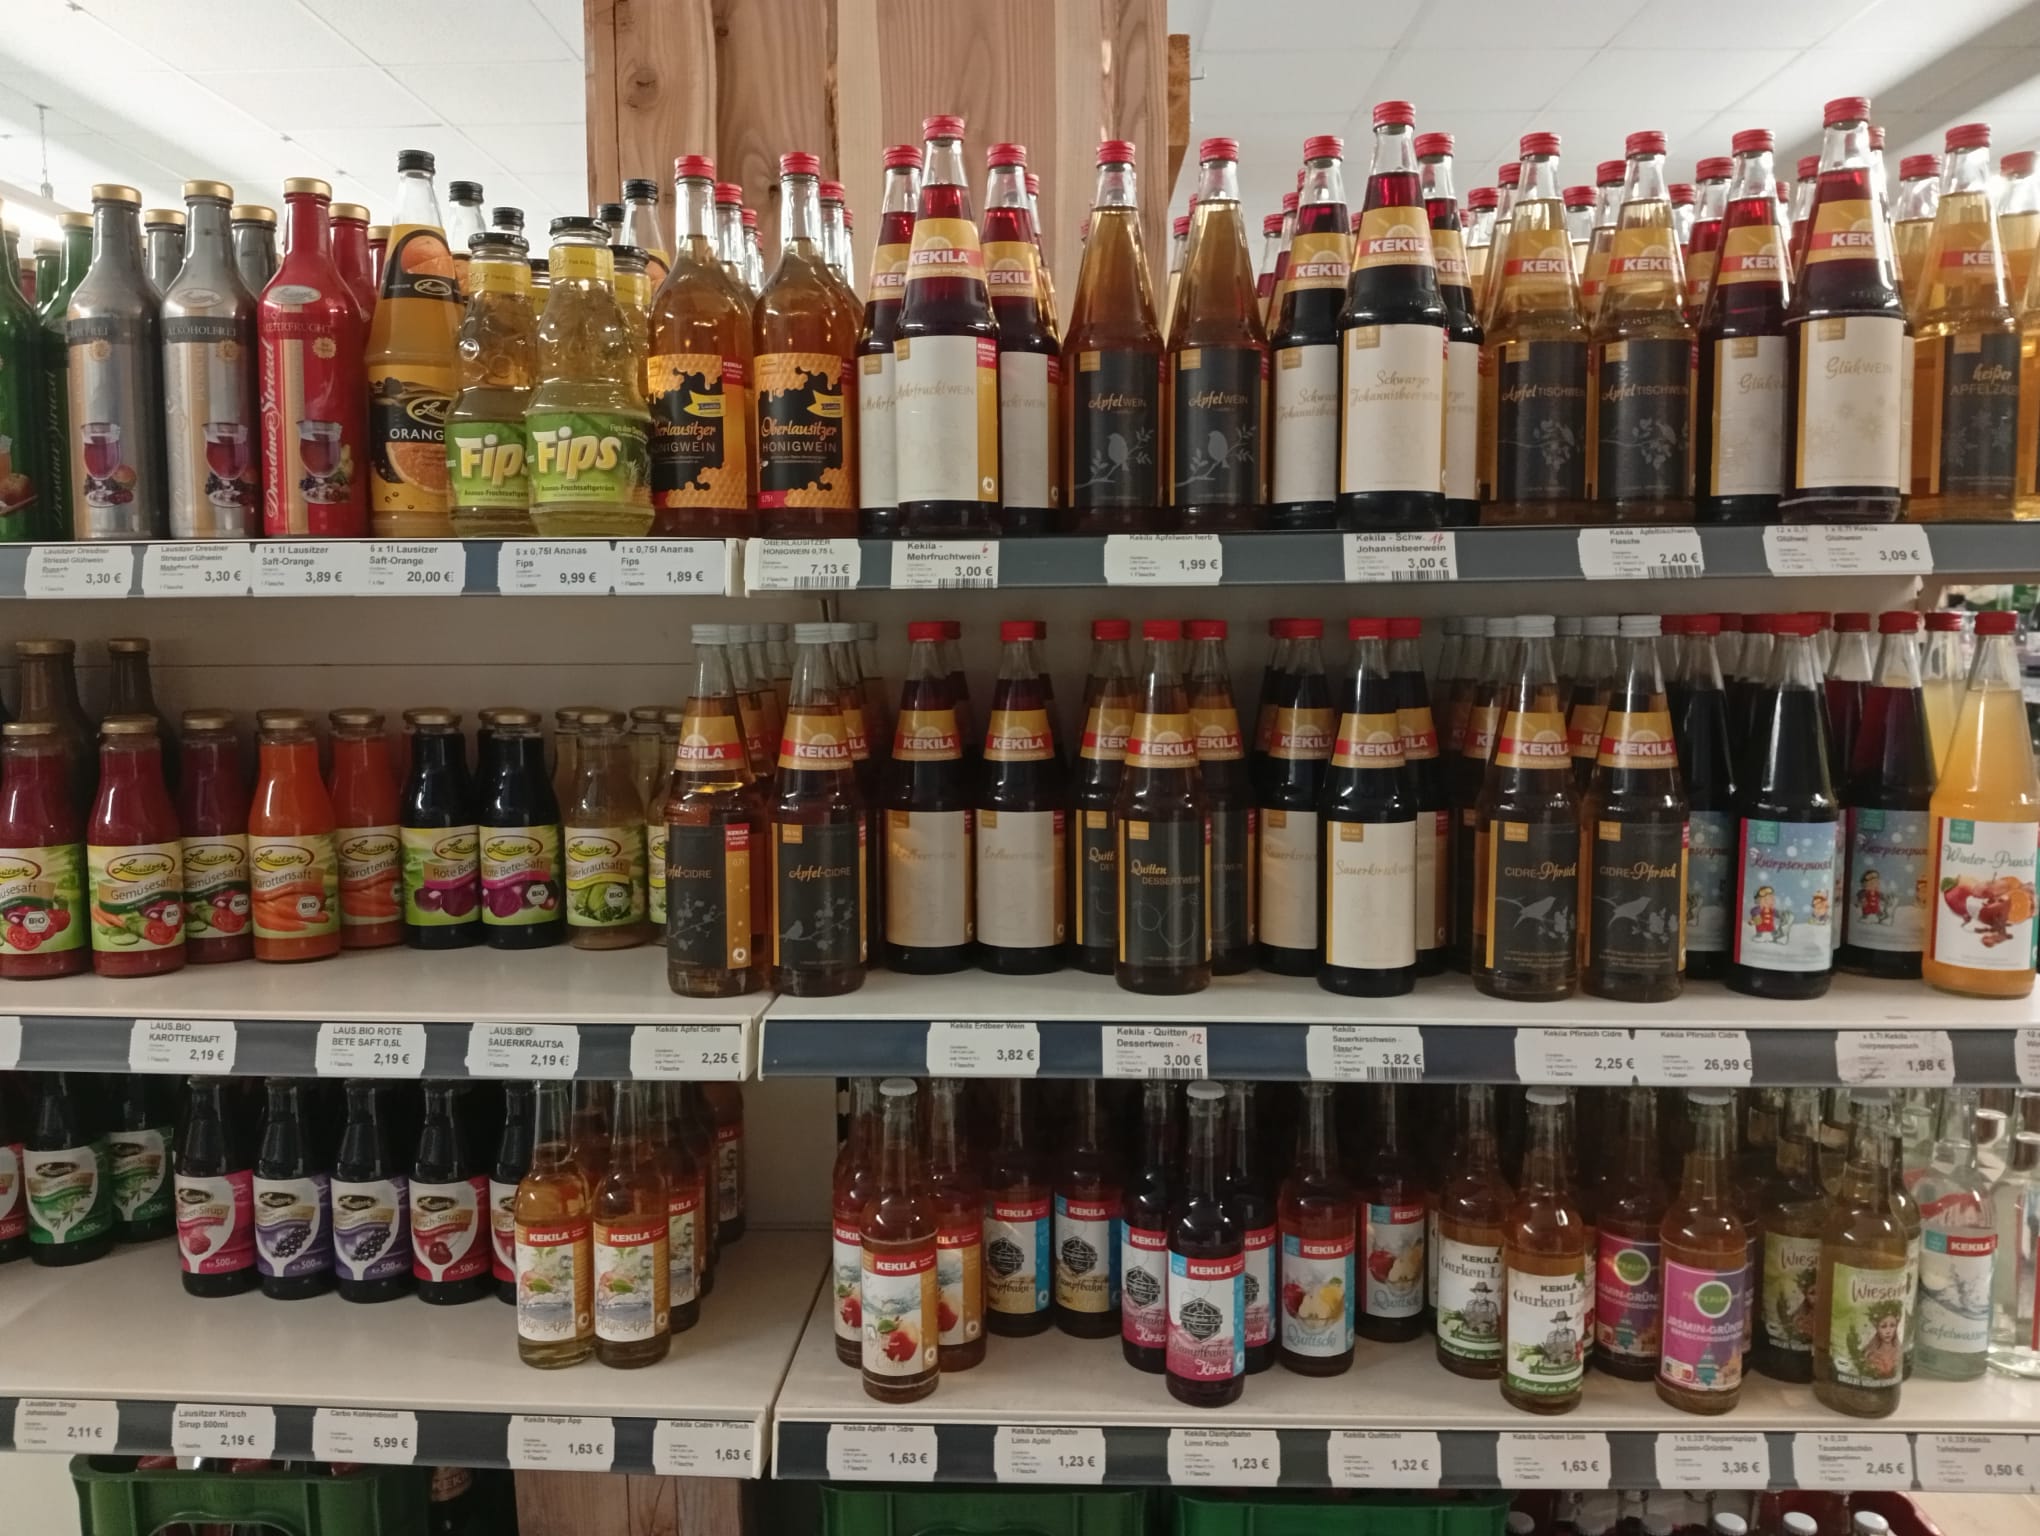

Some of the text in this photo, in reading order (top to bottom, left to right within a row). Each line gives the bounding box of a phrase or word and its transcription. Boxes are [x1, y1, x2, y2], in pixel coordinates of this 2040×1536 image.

[911, 250, 969, 266] KEKILA
[761, 416, 836, 440] Oberlausitzer
[533, 426, 622, 480] Fips
[288, 546, 328, 554] Lausitzer
[554, 547, 587, 555] Ananas
[907, 542, 936, 550] Kekila
[1357, 545, 1446, 553] Johannisbeerwein
[369, 556, 423, 566] Saft-Orange
[1659, 553, 1687, 564] 2,40
[1691, 553, 1699, 563] €
[1880, 550, 1920, 561] 3,09 €
[262, 558, 315, 566] Saft-Orange
[516, 559, 534, 568] Fips
[621, 557, 640, 566] Fips
[1179, 559, 1218, 571] 1,99 €
[1408, 558, 1448, 569] 3,00 €
[811, 564, 849, 576] 7,13 €
[955, 566, 993, 577] 3,00 €
[86, 573, 122, 585] 3,30 €
[205, 570, 241, 582] 3,30 €
[306, 572, 342, 584] 3,89 €
[407, 571, 440, 584] 20,00
[560, 572, 597, 585] 9,99 €
[666, 571, 703, 584] 1,89 €
[903, 737, 954, 749] KEKILA
[992, 736, 1044, 749] KEKILA
[1614, 742, 1672, 754] KEKILA
[794, 746, 847, 758] KEKILA
[1141, 743, 1194, 756] KEKILA
[1131, 859, 1167, 876] Quitten
[28, 916, 45, 924] BIO
[378, 1027, 402, 1035] ROTE
[1154, 1028, 1188, 1036] Quitten
[149, 1034, 220, 1043] KAROTTENSAFT
[332, 1038, 355, 1046] BETE
[488, 1039, 564, 1048] SAUERKRAUTSA
[1117, 1039, 1173, 1047] Dessertwein
[189, 1050, 214, 1061] 2,19
[374, 1053, 399, 1065] 2,19
[531, 1054, 556, 1066] 2,19
[702, 1053, 727, 1064] 2,25
[997, 1049, 1023, 1061] 3,82
[1164, 1055, 1190, 1066] 3,00
[1383, 1054, 1410, 1066] 3,82
[1595, 1058, 1623, 1071] 2,25
[1704, 1059, 1739, 1071] 26,99
[1907, 1060, 1934, 1072] 1,98
[997, 1208, 1032, 1217] KEKILA
[1070, 1207, 1106, 1216] KEKILA
[529, 1231, 569, 1242] KEKILA
[611, 1231, 650, 1242] KEKILA
[1304, 1245, 1342, 1254] KEKILA
[876, 1261, 916, 1271] KEKILA
[1190, 1265, 1231, 1275] KEKILA
[1195, 1360, 1232, 1375] Kirsch
[68, 1427, 91, 1438] 2,11
[1209, 1431, 1251, 1439] Dampfbahn
[221, 1435, 244, 1446] 2,19
[373, 1437, 398, 1449] 5,99
[1032, 1438, 1051, 1446] Apfel
[568, 1444, 593, 1455] 1,63
[715, 1449, 740, 1462] 1,63
[889, 1453, 916, 1464] 1,63
[1058, 1456, 1084, 1468] 1,23
[1232, 1458, 1258, 1470] 1,23
[1391, 1459, 1417, 1472] 1,32
[1561, 1460, 1588, 1472] 1,63
[1722, 1462, 1749, 1475] 3,36
[1867, 1463, 1893, 1475] 2,45
[1985, 1465, 2012, 1477] 0,50
